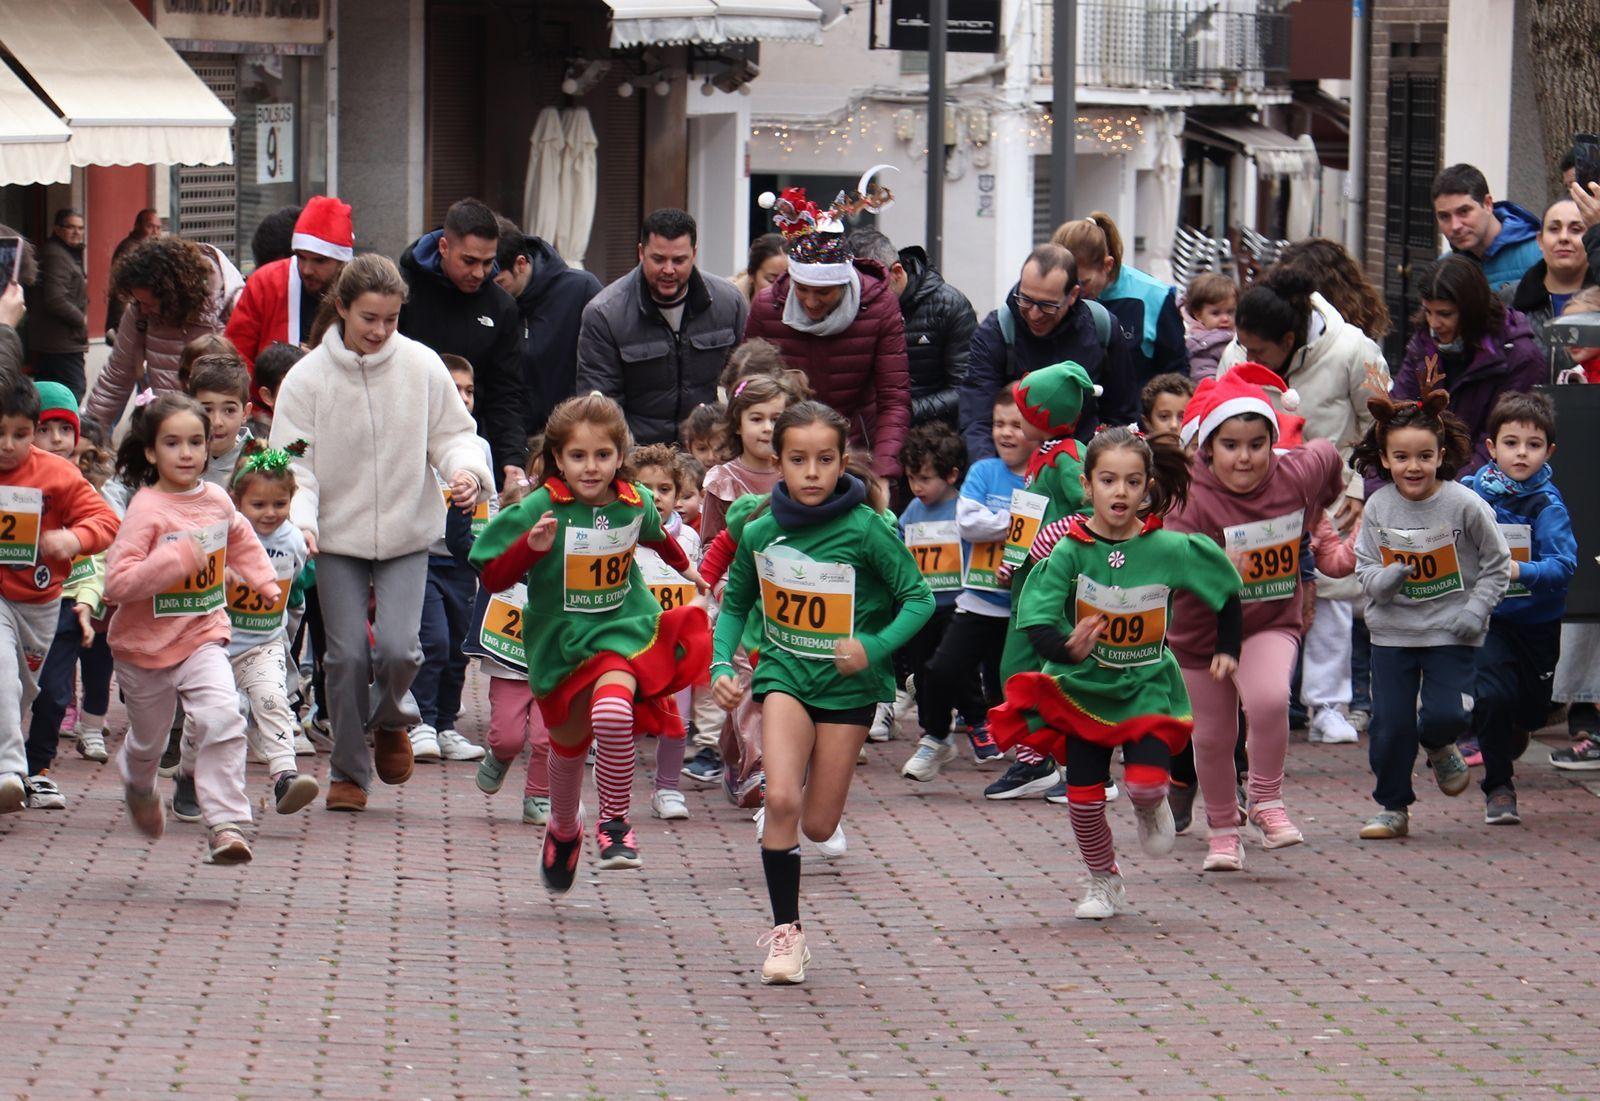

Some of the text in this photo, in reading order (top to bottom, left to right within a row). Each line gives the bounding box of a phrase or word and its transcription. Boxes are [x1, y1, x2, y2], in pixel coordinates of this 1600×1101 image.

[257, 106, 291, 123] BOLSOS
[267, 126, 277, 178] 9
[1, 515, 16, 540] 2
[590, 552, 631, 587] 182
[1249, 544, 1294, 579] 399
[1255, 585, 1263, 595] DE
[1266, 578, 1297, 594] EXTREMA
[1412, 578, 1458, 596] EXTREMADURA
[159, 598, 180, 610] JUNTA
[183, 597, 192, 607] DE
[570, 594, 591, 606] JUNTA
[594, 594, 604, 604] DE
[776, 590, 826, 629] 270
[781, 631, 790, 643] DE
[500, 641, 511, 653] DE
[1109, 647, 1158, 661] EXTREMADURA
